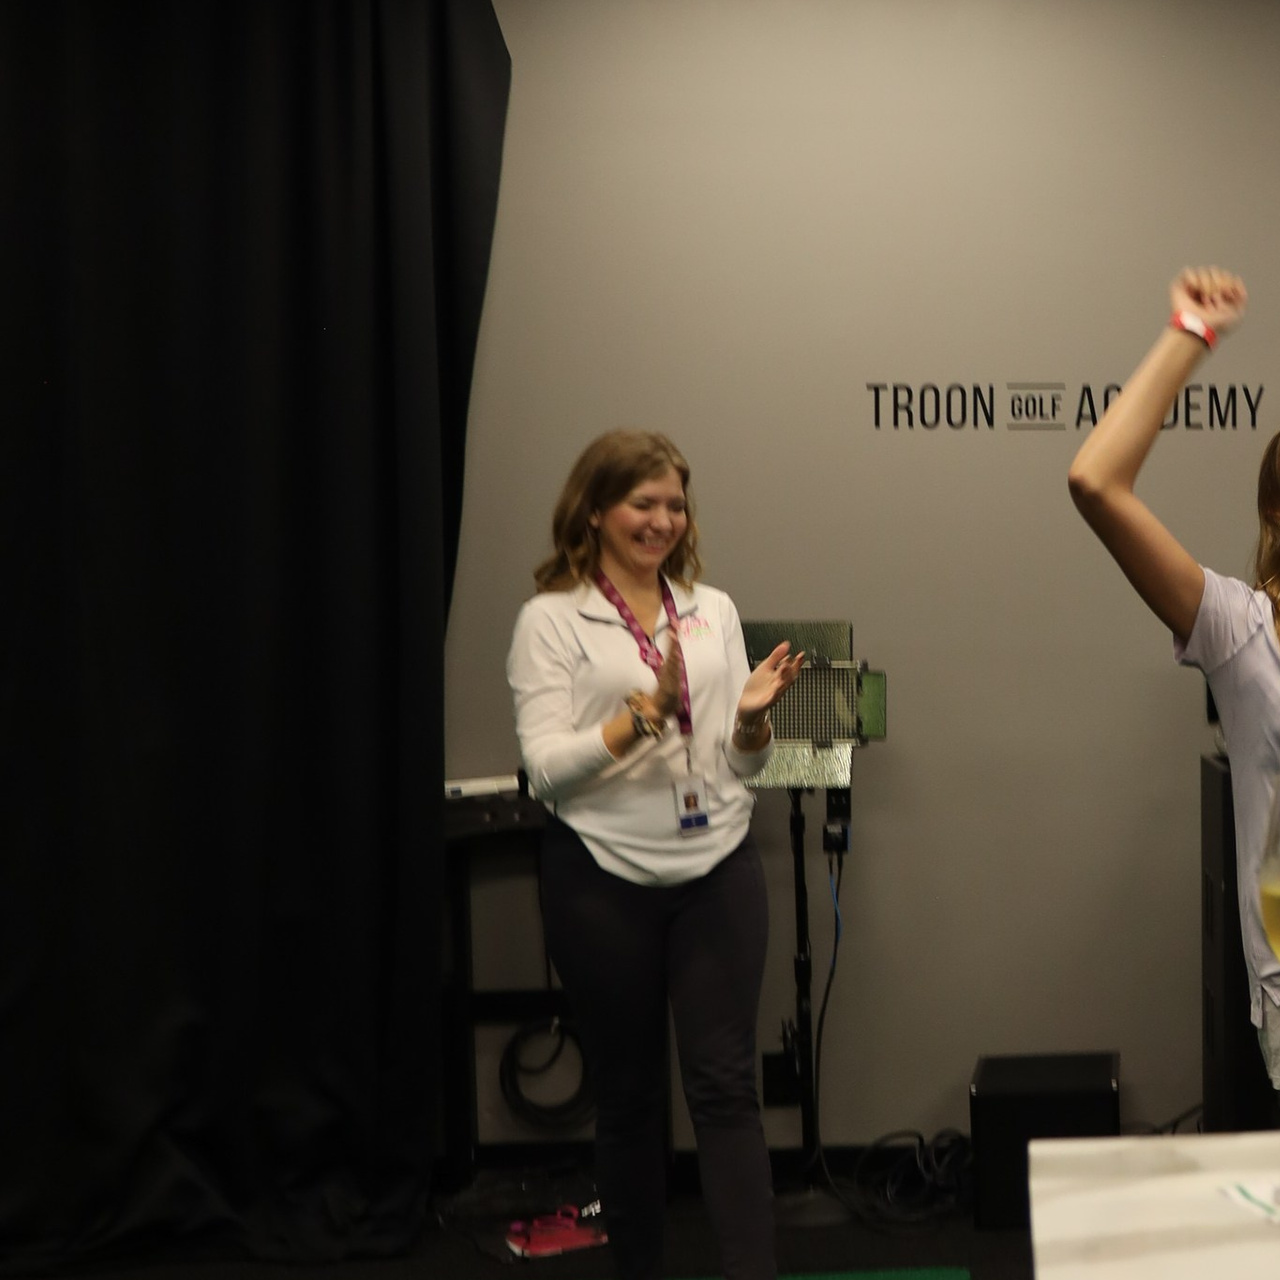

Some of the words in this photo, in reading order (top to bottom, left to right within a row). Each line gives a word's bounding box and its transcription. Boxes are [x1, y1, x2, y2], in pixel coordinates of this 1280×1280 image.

[866, 383, 994, 430] TROON
[1010, 393, 1062, 420] GOLF
[1075, 384, 1264, 430] ACEMY
